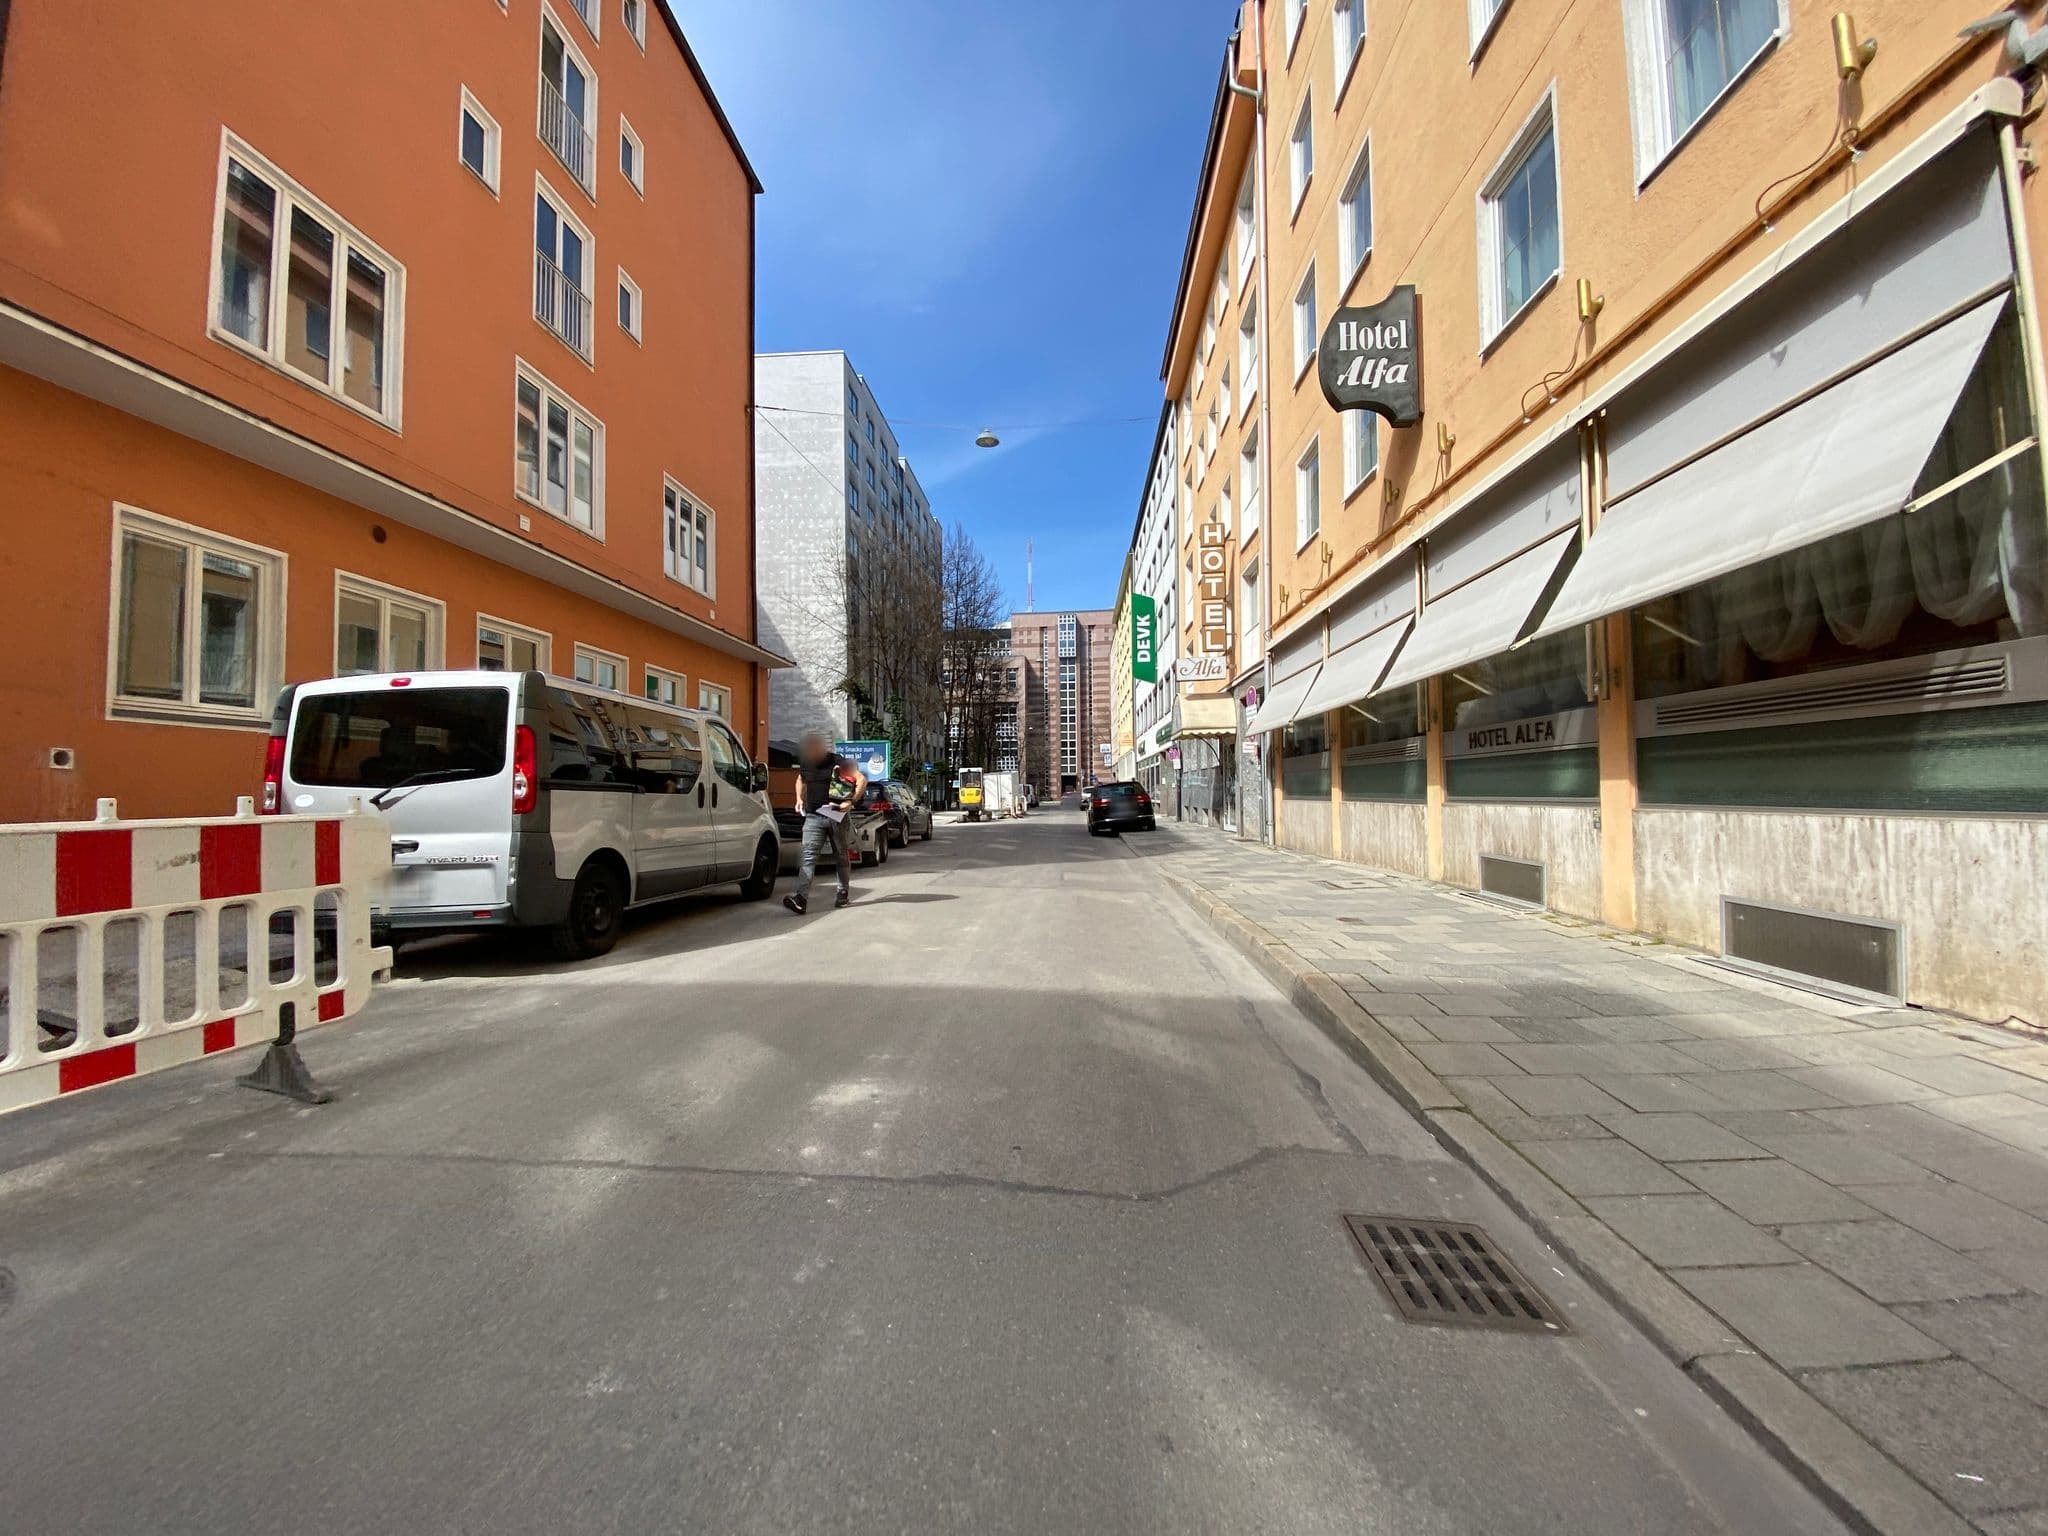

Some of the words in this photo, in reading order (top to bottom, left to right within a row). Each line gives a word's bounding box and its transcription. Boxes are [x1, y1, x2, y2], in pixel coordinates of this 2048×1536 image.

[1338, 319, 1409, 351] Hotel
[1337, 355, 1409, 389] Alfa
[1203, 524, 1224, 650] HOTEL
[1136, 614, 1151, 663] DEVK
[1179, 658, 1222, 677] Alfa
[1468, 727, 1511, 749] HOTEL
[1515, 720, 1555, 744] ALFA
